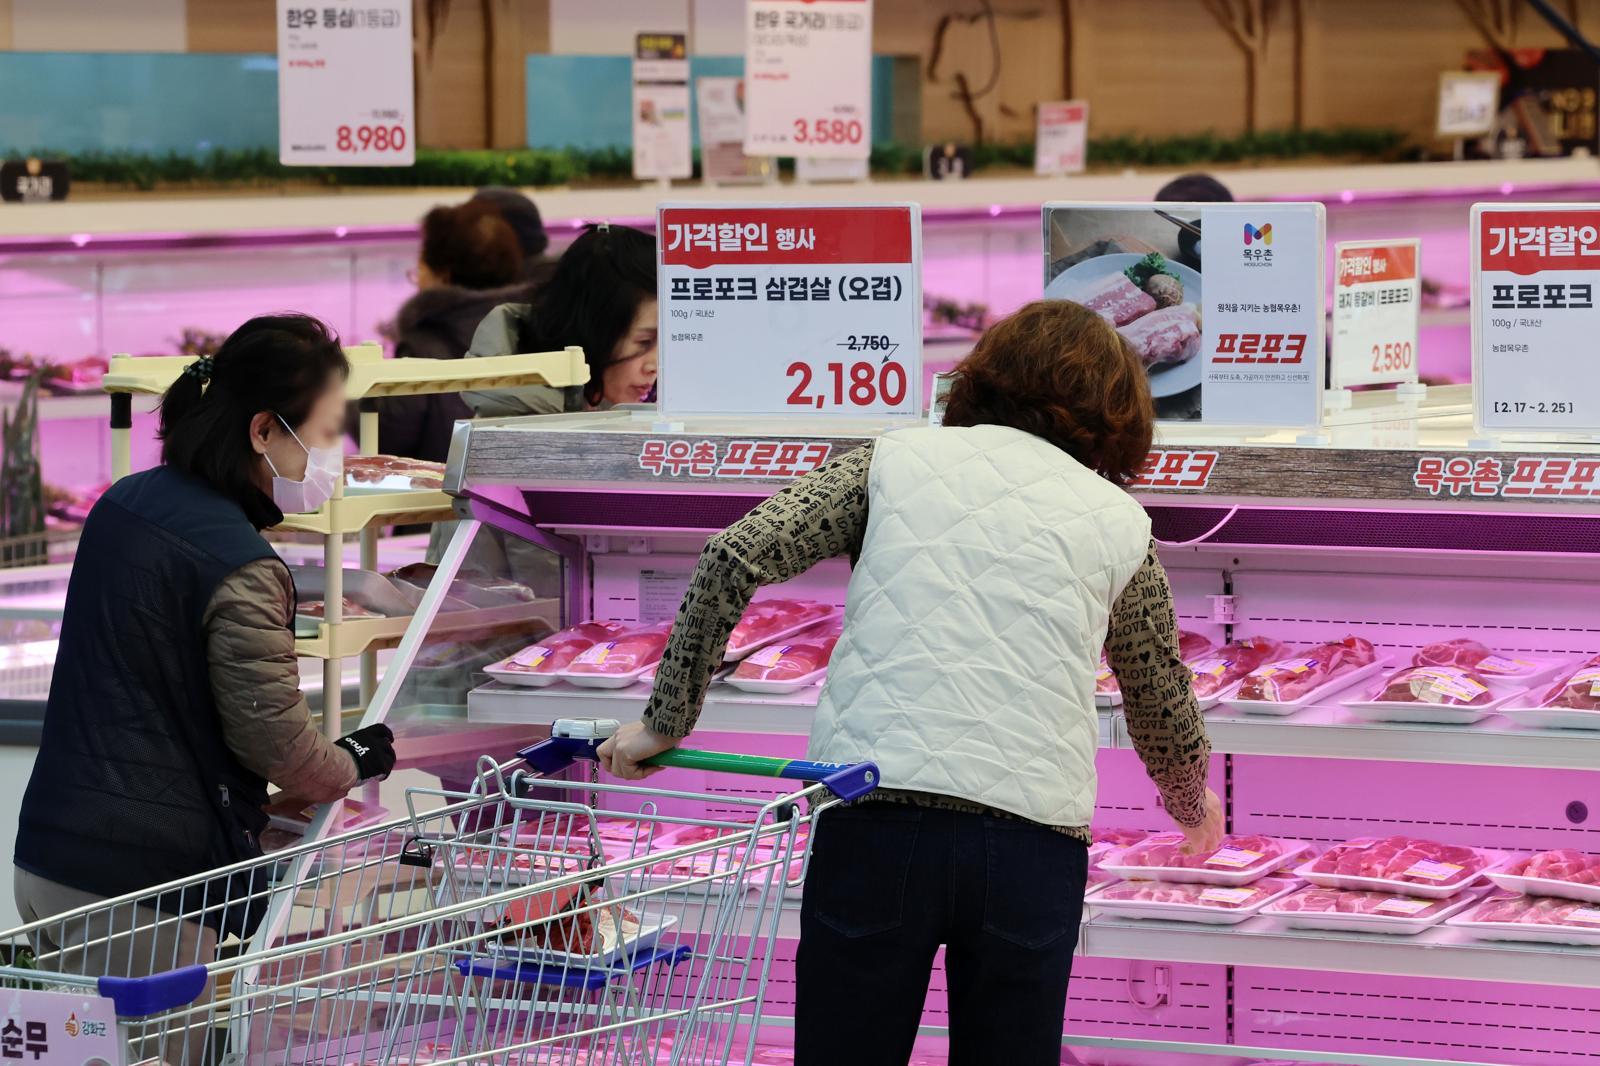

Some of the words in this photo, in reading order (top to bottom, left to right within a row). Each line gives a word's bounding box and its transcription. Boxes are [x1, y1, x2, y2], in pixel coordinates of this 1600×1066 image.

[287, 9, 317, 29] 한우
[337, 125, 406, 154] 8,980
[793, 118, 862, 145] 3,580
[667, 223, 769, 252] 가격할인
[775, 228, 815, 251] 행사
[1489, 225, 1600, 257] 가격할인
[1243, 249, 1274, 261] 목우촌
[671, 277, 758, 301] 프로포크
[765, 276, 832, 301] 삼겹살
[838, 275, 903, 302] (오겹)
[1492, 284, 1592, 309] 프로포크
[671, 309, 688, 319] 100g
[695, 309, 715, 318] 국내산
[1217, 303, 1239, 313] 원칙을
[1239, 303, 1261, 313] 지키는
[1262, 303, 1301, 313] 농협목우촌!
[1492, 319, 1511, 329] 100g
[1519, 318, 1542, 328] 국내산
[847, 335, 890, 351] 2,750
[1211, 333, 1307, 364] 프로포크
[1492, 343, 1529, 353] 농협목우촌
[1372, 342, 1411, 373] 2,580
[786, 361, 907, 408] 2,180
[640, 440, 717, 476] 목우촌
[1413, 457, 1503, 496] 목우촌
[1501, 457, 1600, 499] 프로포
[1114, 620, 1149, 637] LOVE
[661, 660, 688, 684] LOVE
[1122, 665, 1157, 680] LOVE
[1, 1018, 48, 1060] 순무
[82, 1020, 107, 1037] 강화군
